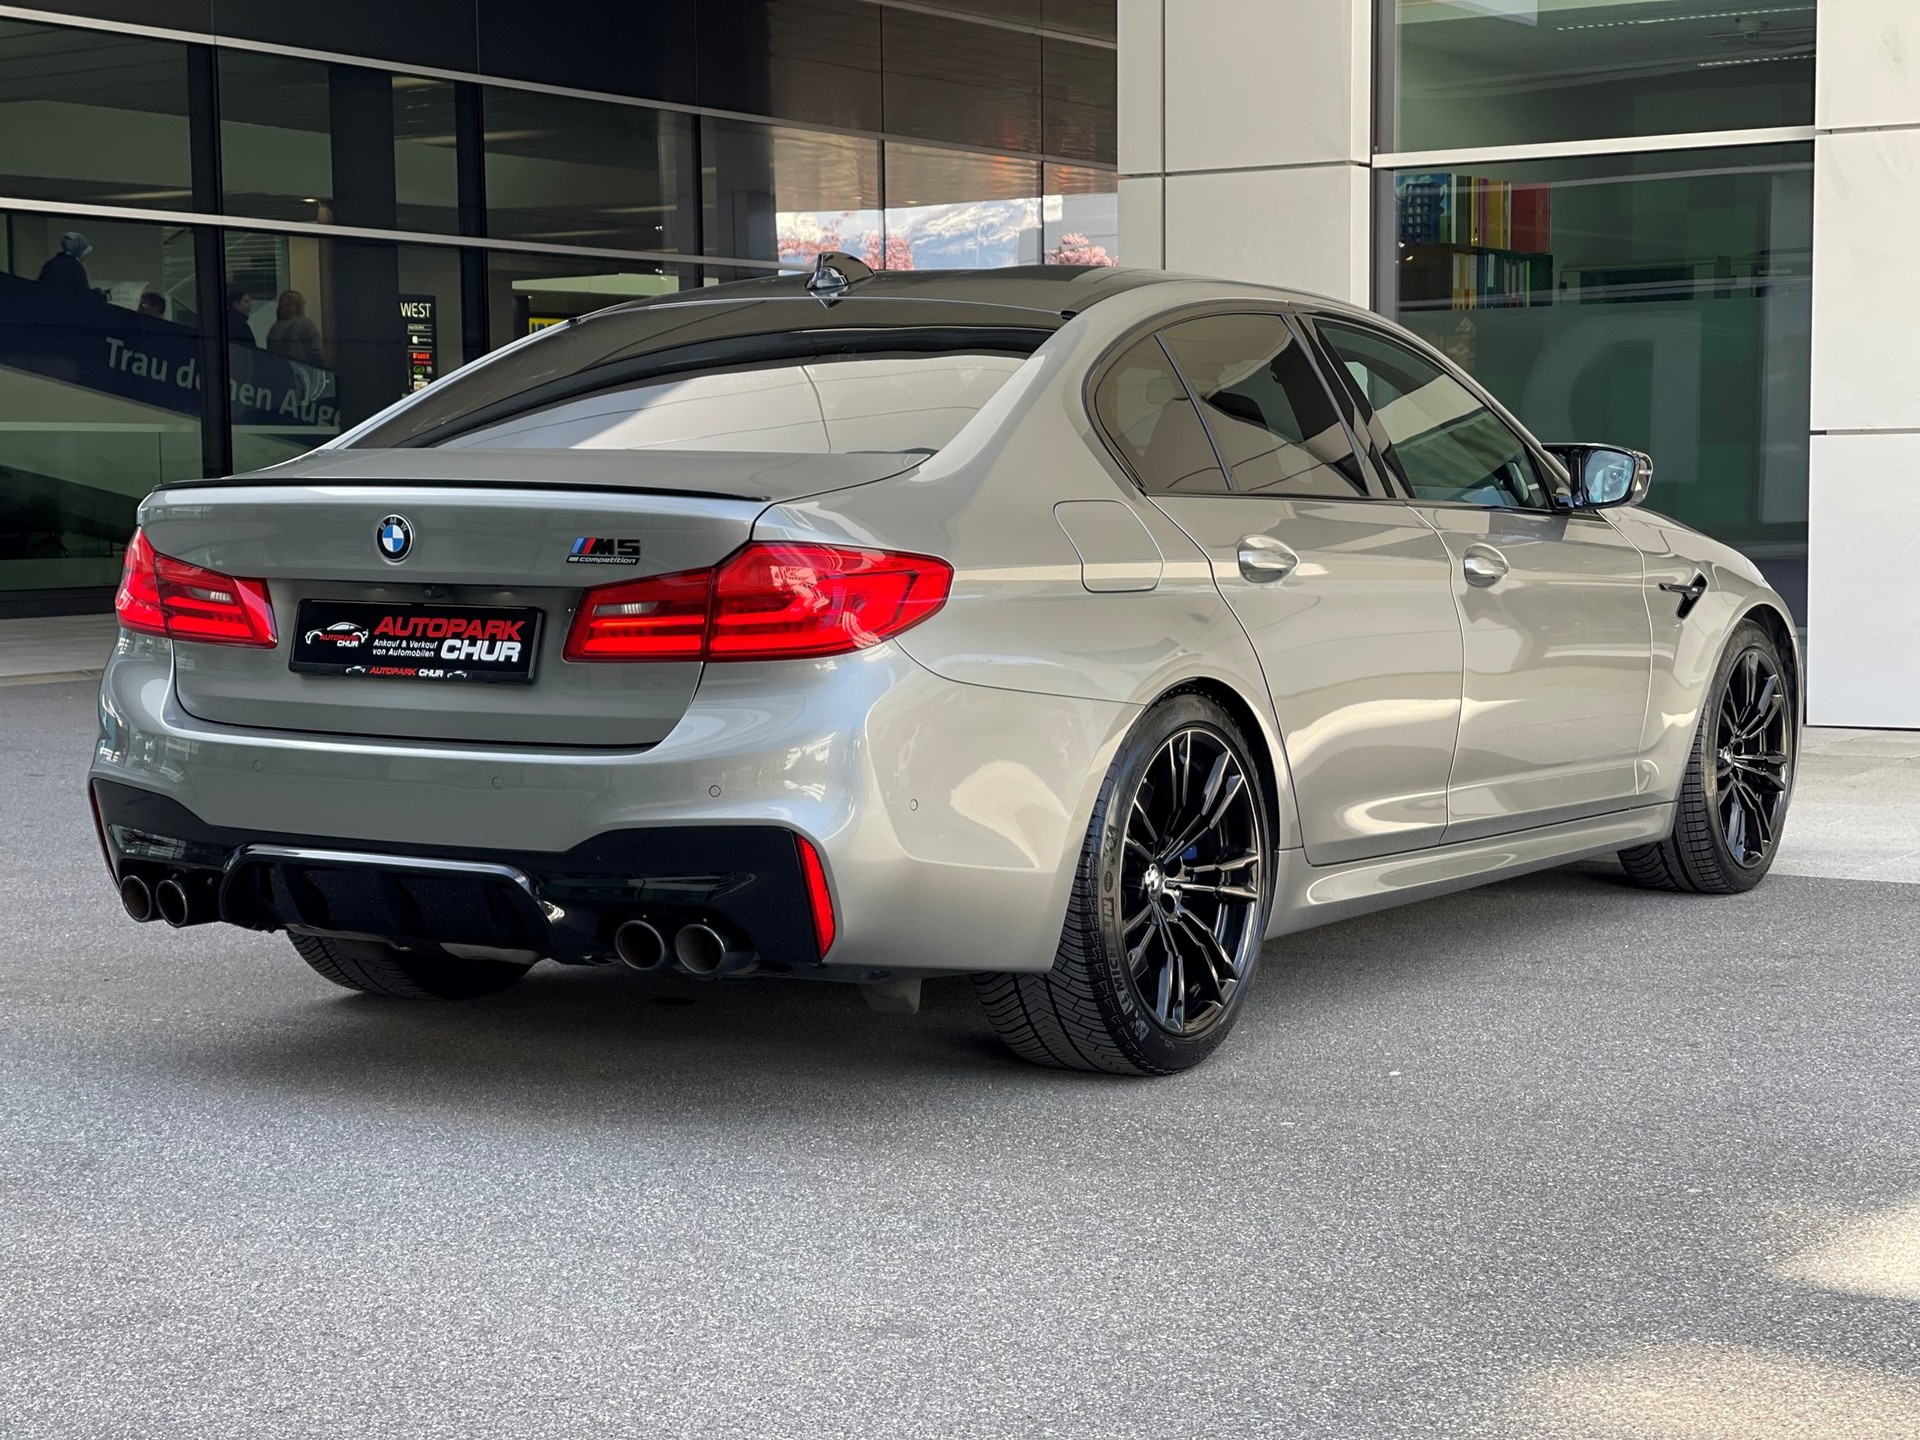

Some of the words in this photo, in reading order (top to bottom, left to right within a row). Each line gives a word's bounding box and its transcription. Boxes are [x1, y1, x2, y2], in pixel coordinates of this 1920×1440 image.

[400, 302, 431, 317] WEST
[106, 337, 168, 382] Trau
[176, 358, 272, 411] dnen
[380, 517, 408, 531] BMW
[588, 538, 641, 555] M5
[578, 556, 637, 564] competition
[374, 616, 525, 640] AUTOPARK
[320, 634, 359, 642] AUTOPARK
[373, 639, 400, 648] Ankauf
[401, 640, 407, 648] &
[409, 641, 438, 649] Verkauf
[388, 648, 435, 658] Automobilen
[440, 639, 521, 662] CHUR
[369, 666, 417, 676] AUTOPARK
[418, 668, 444, 677] CHUR
